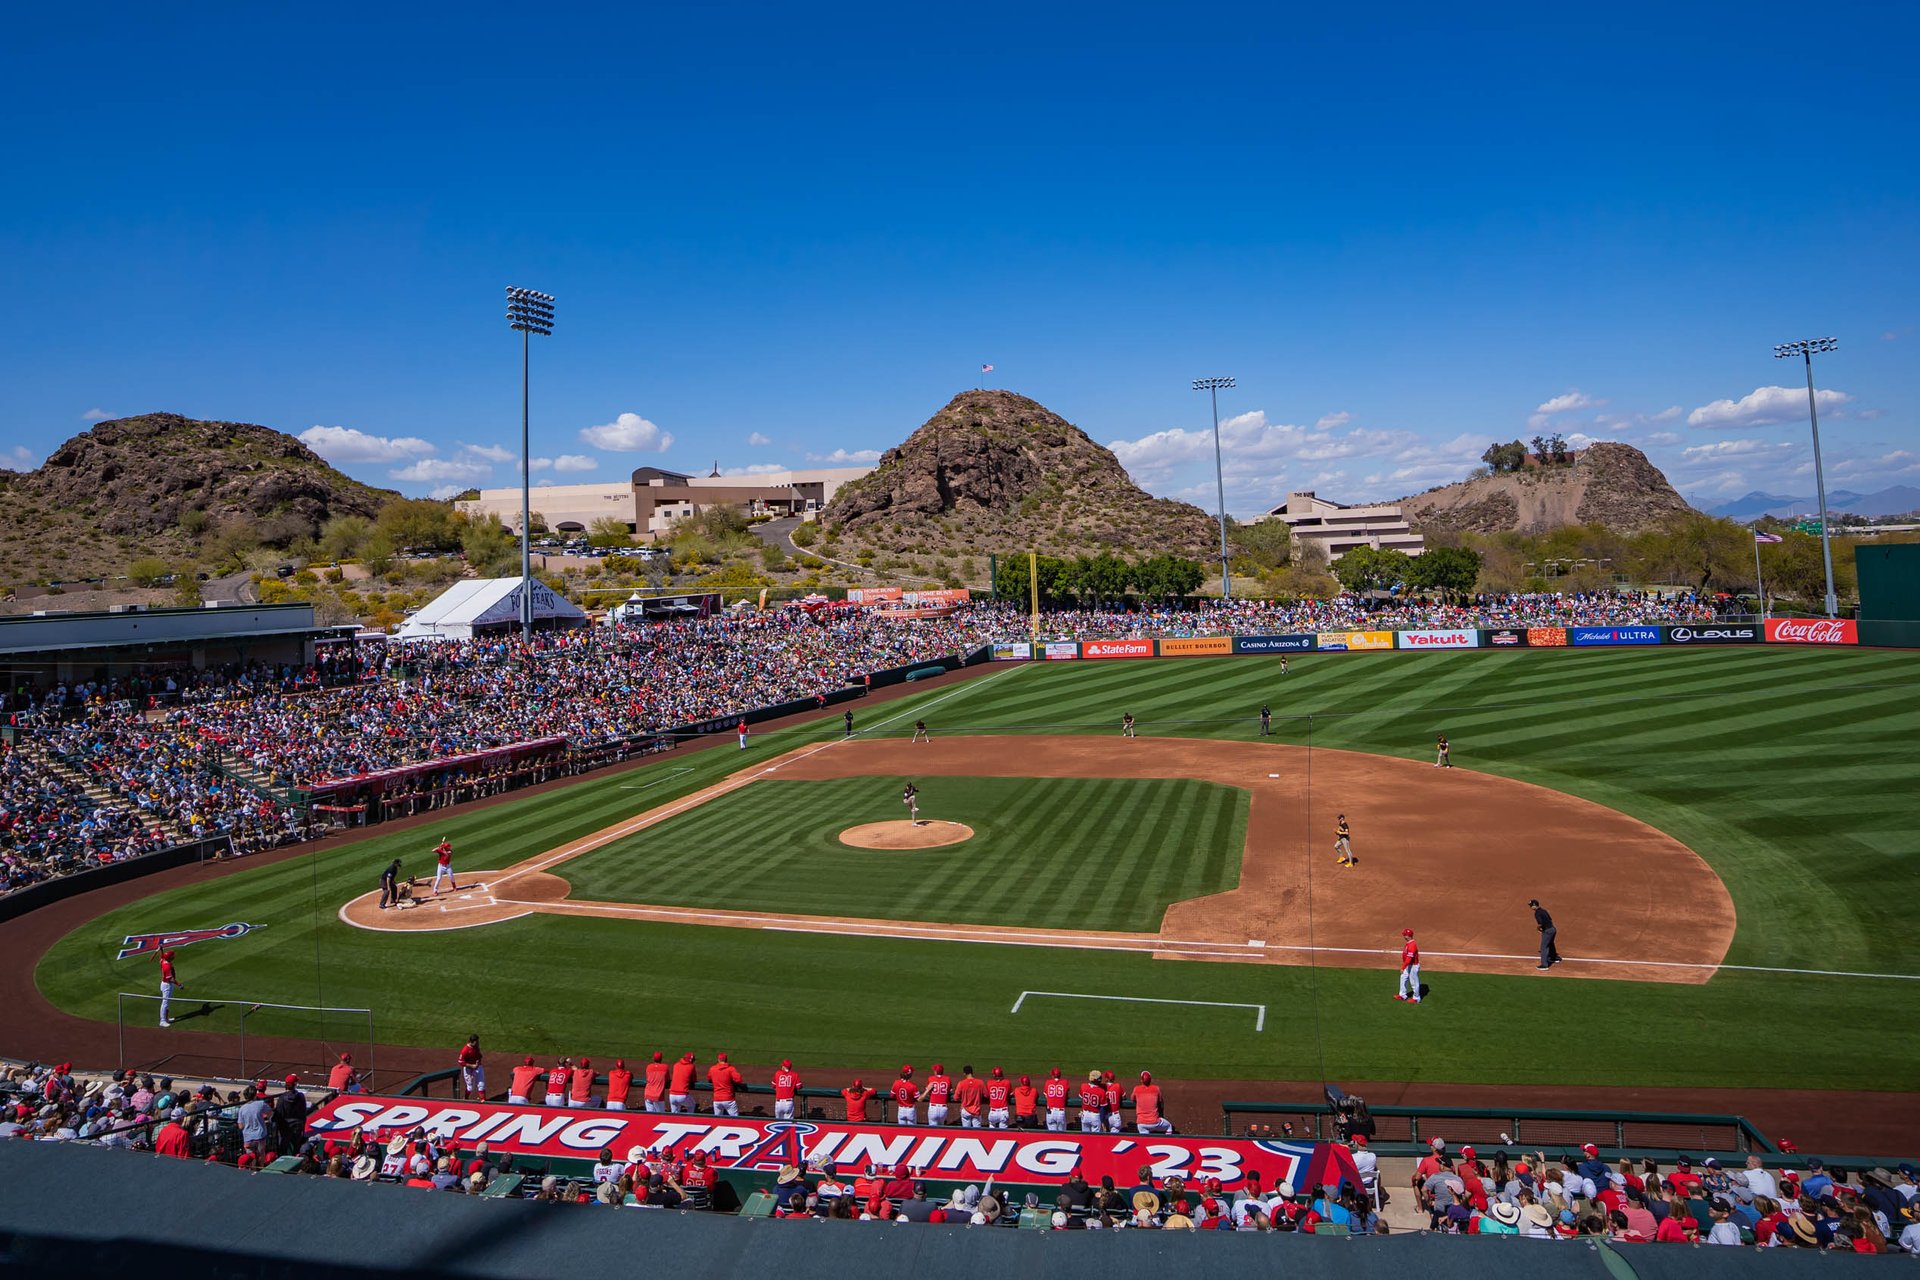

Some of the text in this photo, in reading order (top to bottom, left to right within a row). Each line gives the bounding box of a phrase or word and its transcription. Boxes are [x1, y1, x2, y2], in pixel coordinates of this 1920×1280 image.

[1576, 631, 1656, 641] Michelob ULTRA
[1693, 629, 1754, 638] LEXUS
[1775, 620, 1846, 643] Coca-Cola
[1240, 640, 1300, 649] CASINO ARIZONA
[1406, 634, 1469, 645] Yakult
[778, 1075, 792, 1087] 21
[900, 1088, 907, 1101] 8
[990, 1086, 1006, 1100] 37
[1047, 1084, 1064, 1097] 66
[1082, 1093, 1099, 1107] 58
[309, 1102, 1245, 1183] SPRING TRAINING '23
